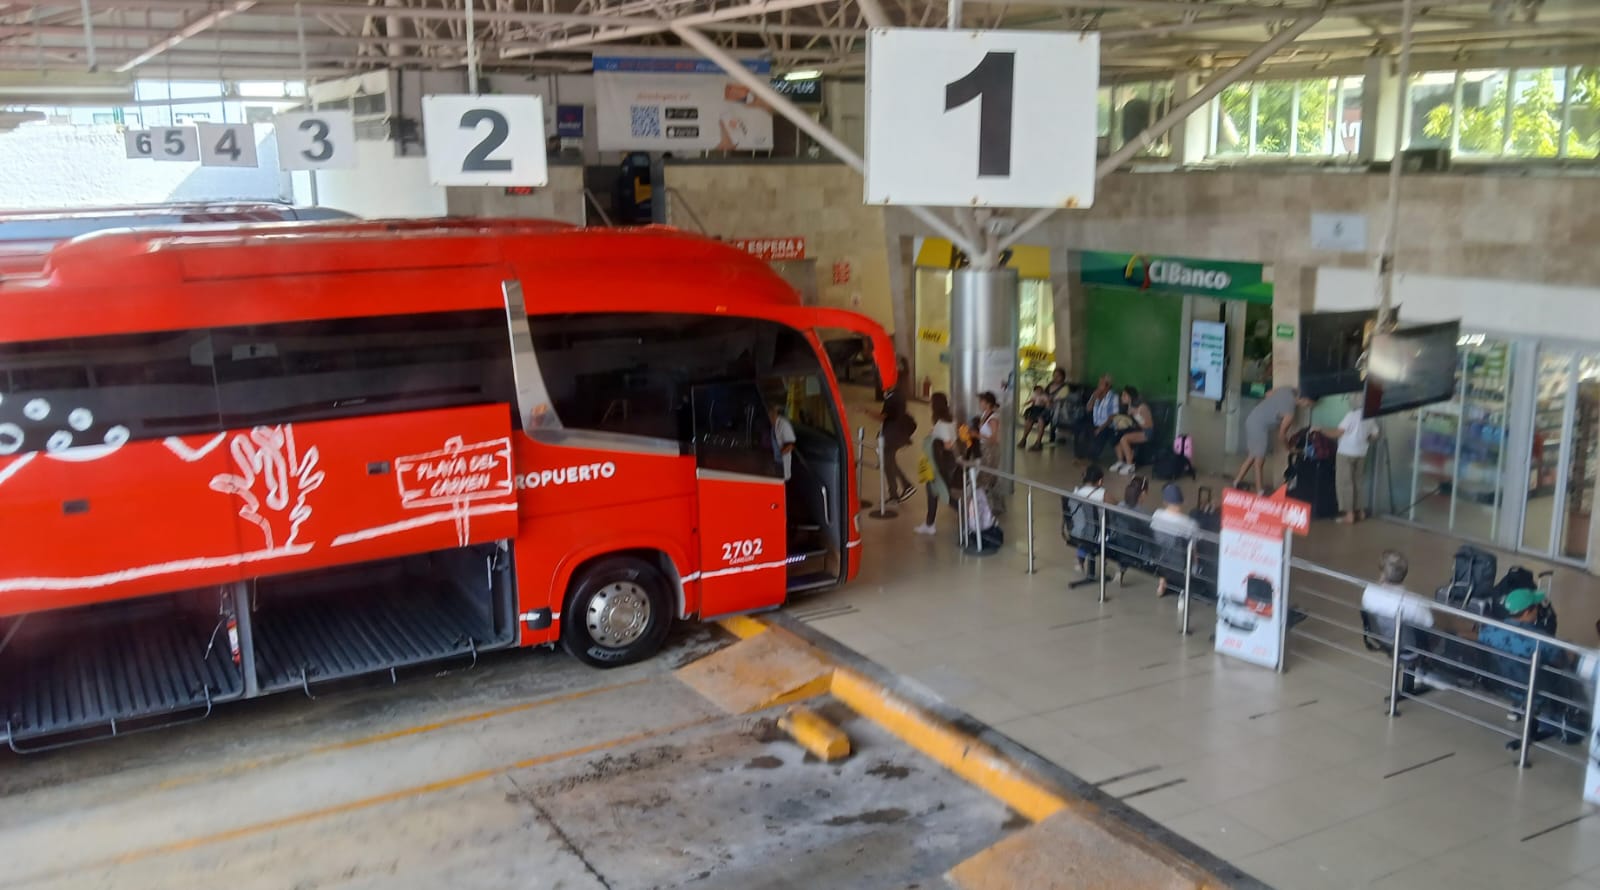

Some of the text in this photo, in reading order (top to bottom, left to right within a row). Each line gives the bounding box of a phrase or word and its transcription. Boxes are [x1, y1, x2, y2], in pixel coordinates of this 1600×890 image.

[944, 51, 1015, 178] 1
[136, 133, 150, 154] 6
[164, 130, 186, 156] 5
[214, 128, 241, 161] 4
[299, 119, 334, 162] 3
[459, 108, 513, 172] 2
[748, 240, 795, 254] ESPERA
[1149, 260, 1229, 290] CIBanco
[922, 330, 942, 343] Hertz
[1025, 350, 1047, 361] Hertz
[469, 453, 500, 473] DEL
[722, 538, 763, 560] 2702
